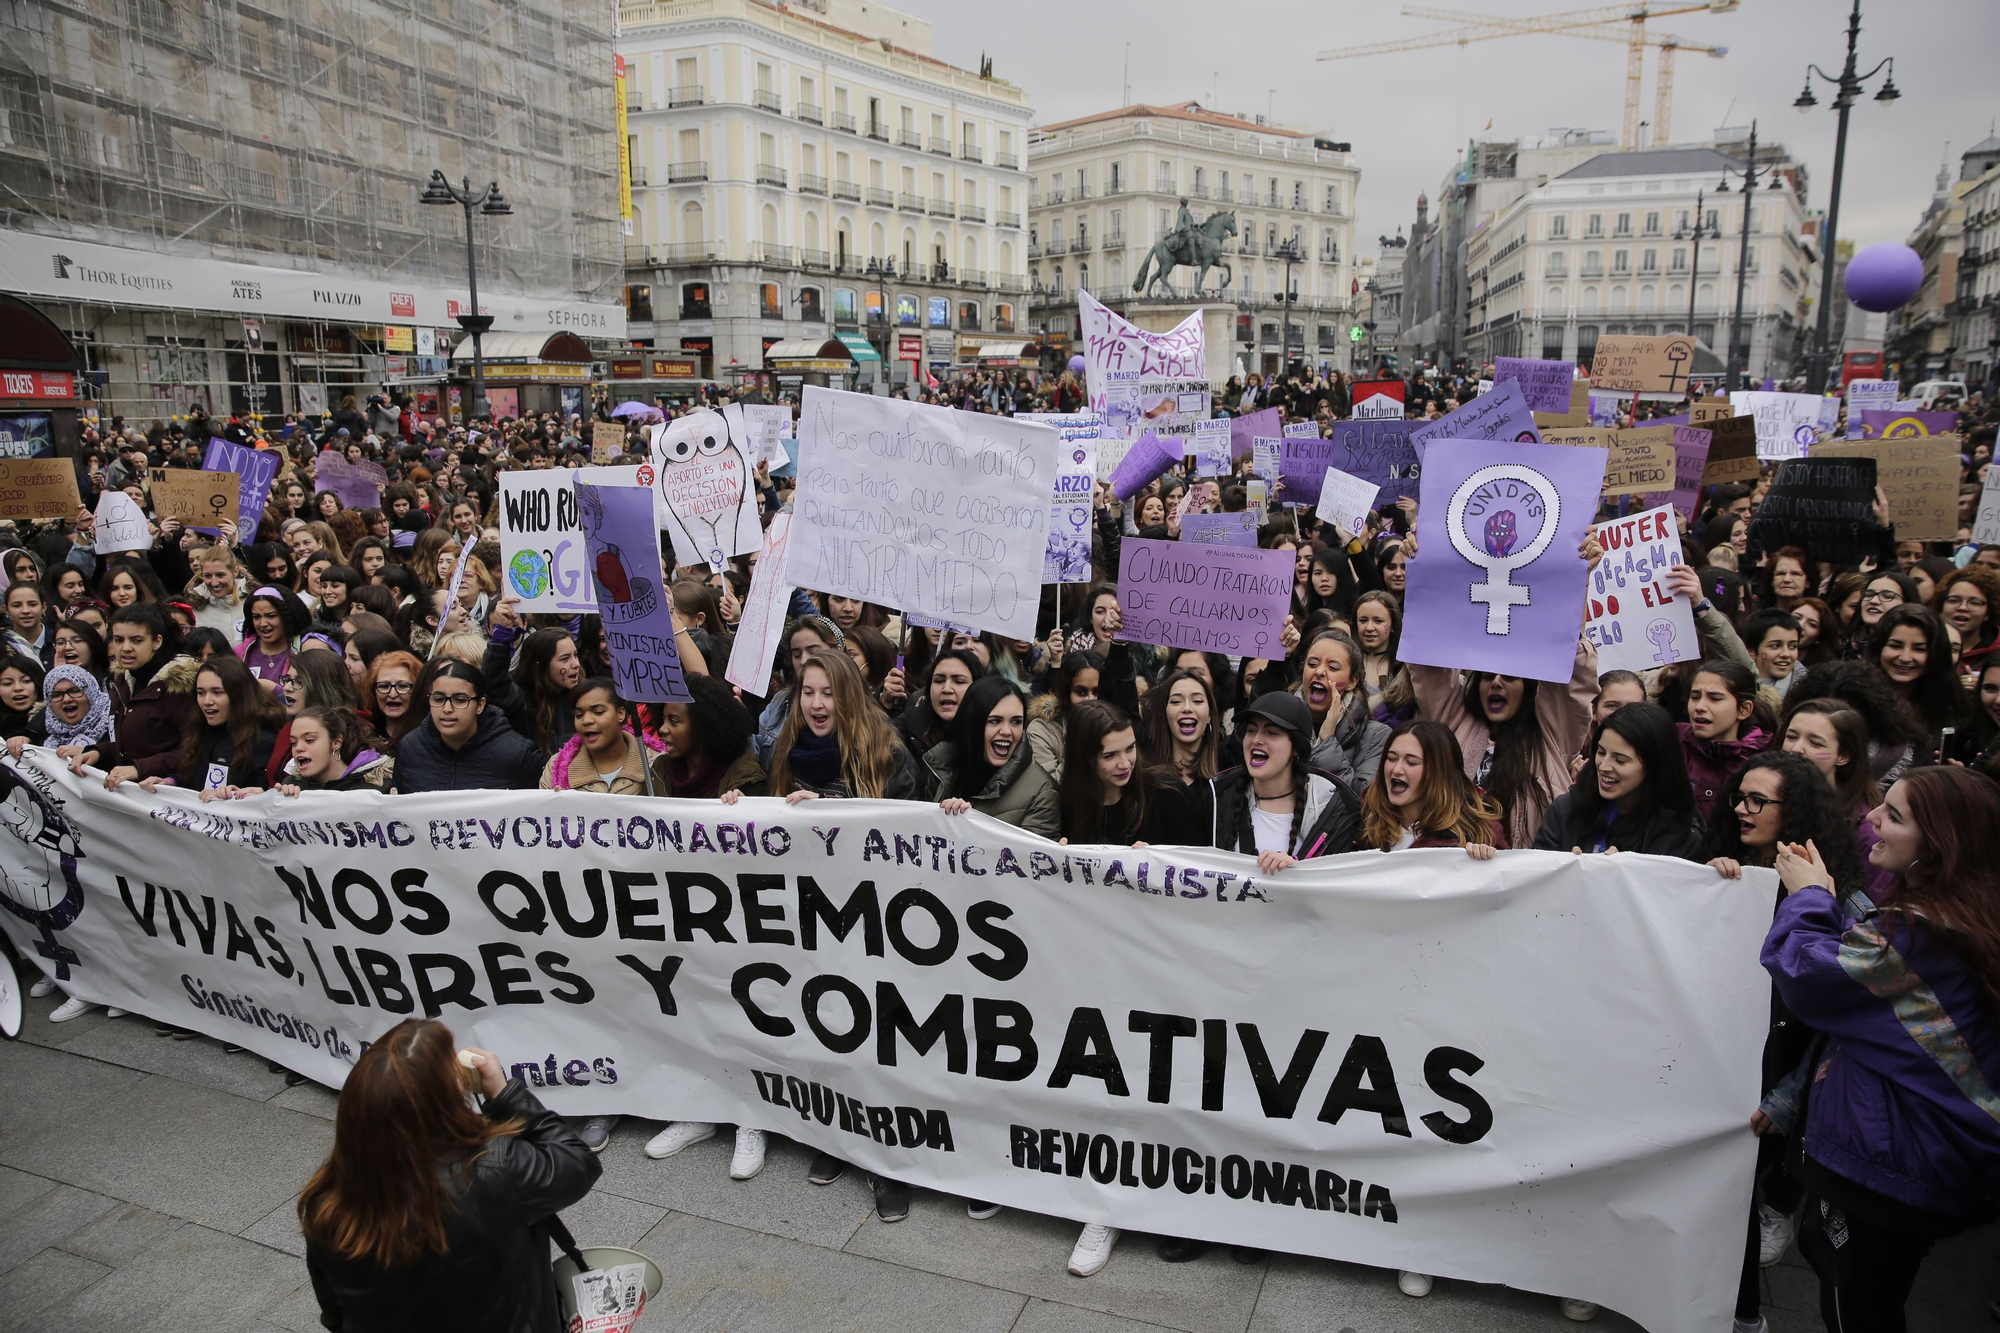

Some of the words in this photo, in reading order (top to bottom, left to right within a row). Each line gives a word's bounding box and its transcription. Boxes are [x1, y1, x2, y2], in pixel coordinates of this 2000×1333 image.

[76, 265, 117, 286] THOR
[121, 272, 173, 291] EQUITIES
[232, 287, 262, 300] ATES
[313, 289, 361, 307] PALAZZO
[391, 293, 413, 306] DEFI
[460, 303, 488, 315] Laec
[548, 310, 606, 328] SEPHORA
[684, 342, 709, 350] Orange
[1631, 342, 1655, 354] AMA
[901, 351, 920, 359] CHANGE
[1594, 356, 1608, 367] NO
[1613, 356, 1638, 366] MATA
[503, 366, 533, 374] EXCURSIONES
[665, 365, 692, 373] TABACOS
[1114, 371, 1140, 380] MARZO
[1501, 361, 1532, 372] SOMOS
[1534, 364, 1547, 373] LAS
[1550, 364, 1571, 374] HIJAS
[1591, 368, 1604, 377] NI
[1608, 368, 1634, 376] HUMILLA
[3, 374, 34, 394] TICKETS
[1498, 373, 1509, 383] DE
[1533, 374, 1567, 386] BRUJAS
[1590, 379, 1602, 387] NI
[1851, 384, 1858, 393] 8
[1861, 382, 1897, 393] MARZO
[1529, 386, 1569, 396] PUDISTEIS
[1357, 400, 1398, 418] Marlboro
[1526, 394, 1559, 408] EMAR
[1695, 409, 1706, 420] SI
[814, 400, 858, 450] Nos
[1197, 421, 1202, 430] 8
[1204, 420, 1230, 429] MARZO
[1292, 423, 1317, 432] MARZO
[1542, 433, 1561, 445] Con
[1286, 443, 1333, 459] NOSOTRA
[1622, 446, 1651, 455] TANTO
[691, 457, 701, 466] EL
[1707, 460, 1754, 477] CALLAS
[667, 468, 702, 486] ABORTO
[704, 466, 714, 475] ES
[719, 459, 736, 471] UNA
[1607, 472, 1626, 486] EL
[1629, 468, 1665, 483] MIEDO
[672, 475, 737, 503] DECISIÓN
[805, 467, 849, 495] Pero
[681, 492, 746, 519] INDIVIDUAL
[1469, 484, 1542, 518] UNIDAS
[3, 504, 28, 515] CON
[504, 487, 550, 533] WHO
[804, 499, 948, 550] QUITANDONOS
[956, 527, 1006, 563] TODO
[814, 536, 908, 604] NUESTRO
[916, 554, 1019, 622] MIEDO
[1128, 547, 1209, 585] CUANDO
[1211, 566, 1291, 596] TRATARON
[1128, 590, 1159, 610] DE
[1144, 618, 1241, 650] GRITAMOS
[238, 819, 416, 849] FEMINISMO
[429, 815, 792, 857] REVOLUCIONARIO
[812, 825, 841, 857] Y
[862, 828, 1273, 903] ANTICAPITALISTA
[274, 865, 450, 936] NOS
[477, 868, 1029, 981] QUEREMOS
[115, 874, 305, 987] VIVAS,
[302, 936, 595, 1018] LIBRES
[615, 954, 684, 1017] Y
[731, 962, 1493, 1144] COMBATIVAS
[180, 973, 321, 1050] Sindicato
[750, 1069, 956, 1152] IZQUIERDA
[1009, 1124, 1399, 1224] REVOLUCIONARIA
